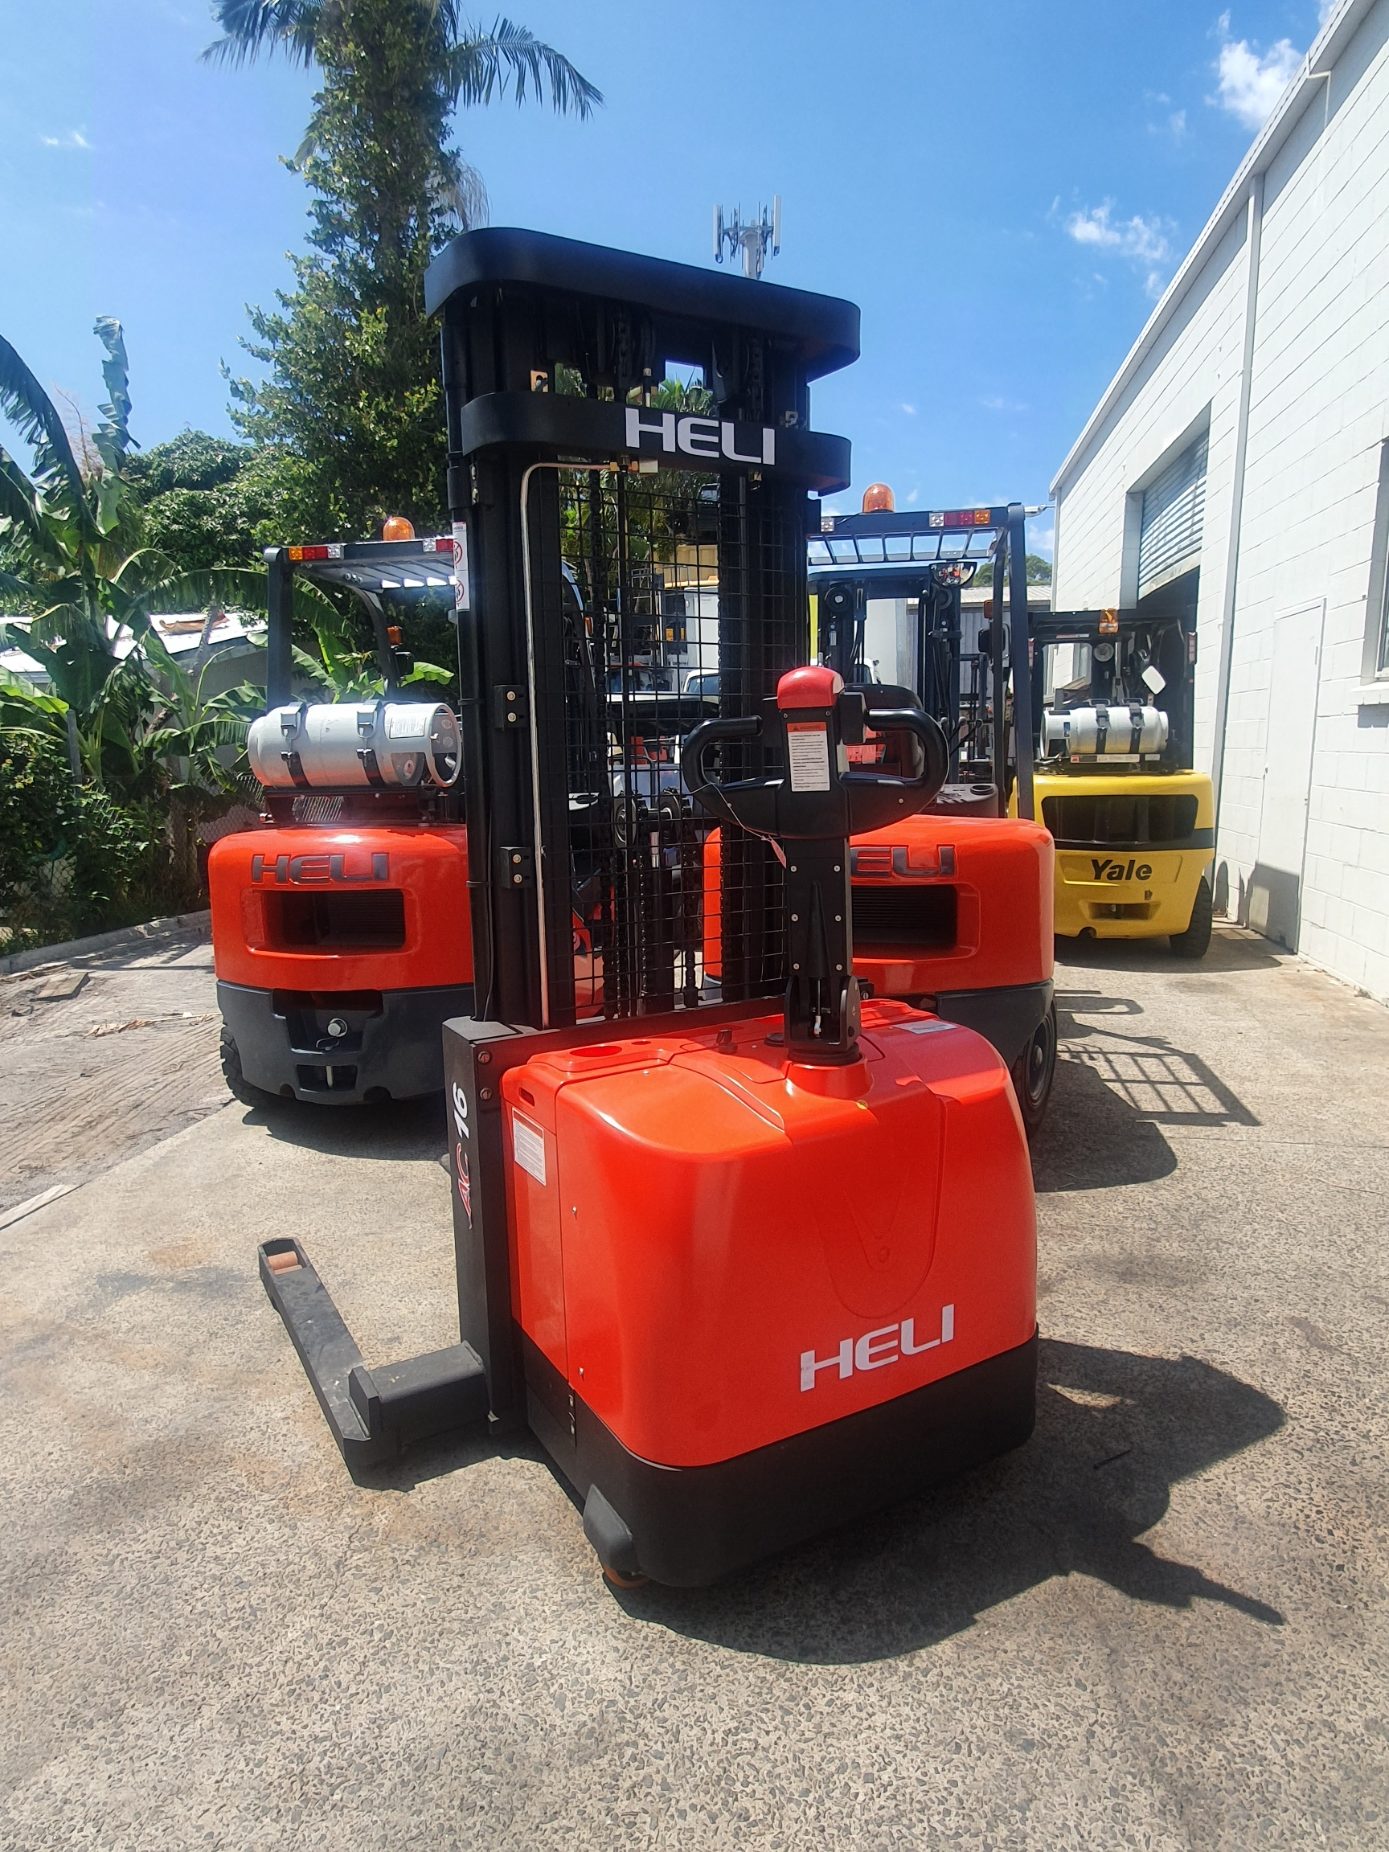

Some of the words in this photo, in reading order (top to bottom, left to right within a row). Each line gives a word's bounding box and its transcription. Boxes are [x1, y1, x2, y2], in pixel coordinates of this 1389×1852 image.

[625, 408, 775, 465] HELI
[252, 853, 389, 883] HELI
[850, 845, 955, 877] ELI
[1091, 859, 1153, 880] Yale
[453, 1082, 469, 1139] 16
[800, 1304, 954, 1392] HELI
